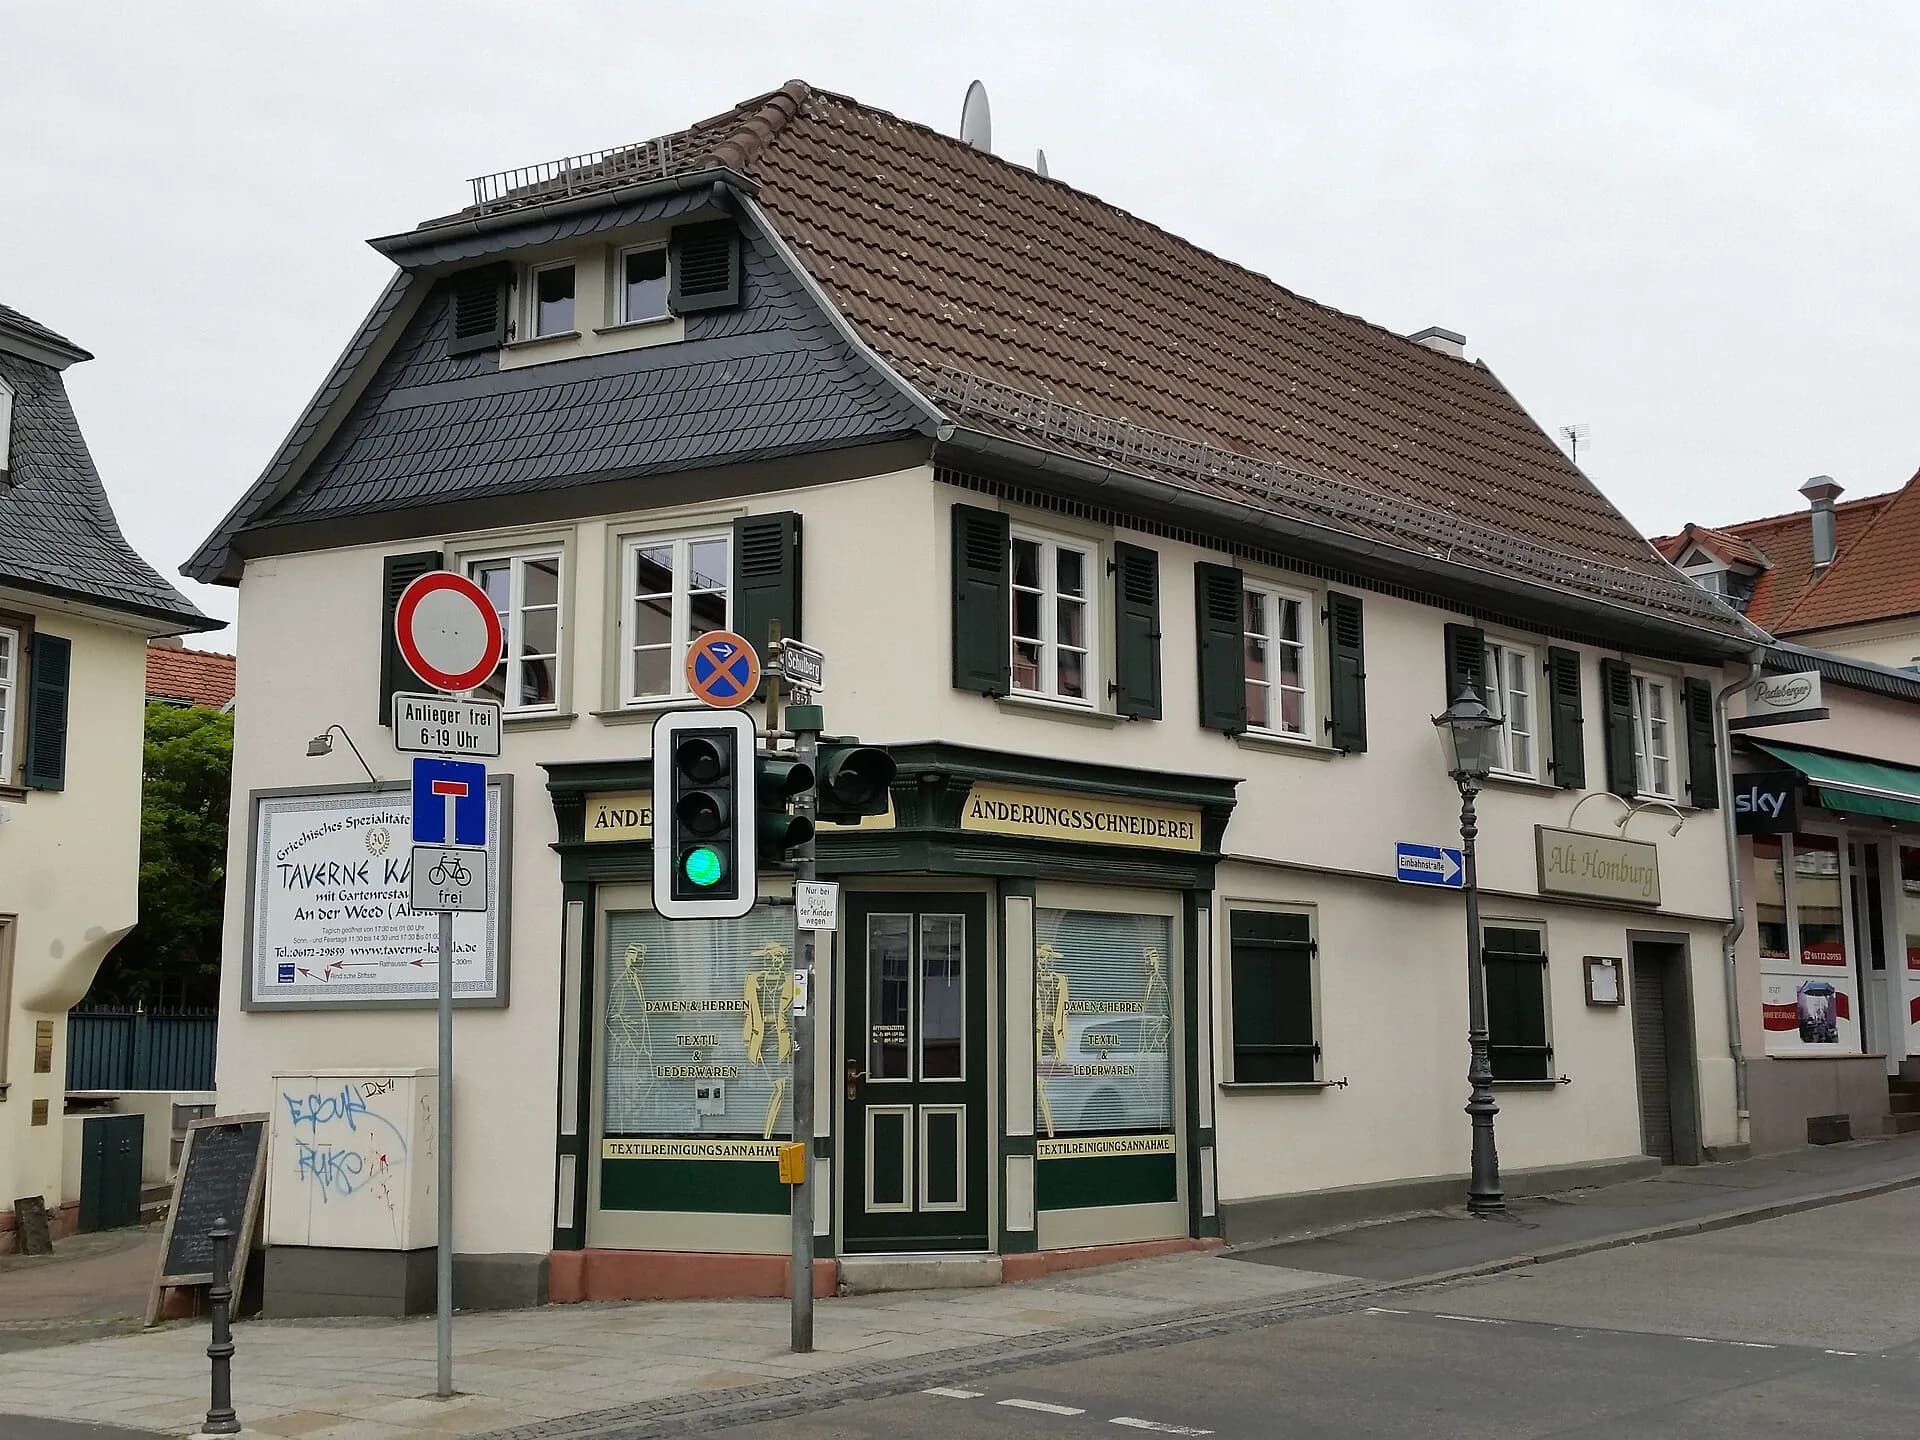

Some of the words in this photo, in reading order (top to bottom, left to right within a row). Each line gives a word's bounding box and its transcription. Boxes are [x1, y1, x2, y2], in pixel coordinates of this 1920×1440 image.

[788, 651, 820, 680] Schulberg
[1754, 681, 1808, 701] Radeberger
[405, 703, 460, 725] Anlieger
[469, 708, 491, 726] frei
[420, 728, 450, 747] 6-19
[457, 731, 478, 748] Uhr
[1736, 786, 1787, 818] sky
[594, 806, 652, 829] ÄNDE
[969, 794, 1194, 840] ÄNDERUNGSSCHNEIDEREI
[276, 822, 343, 861] Griechisches
[345, 811, 411, 830] Spezialitäte
[371, 832, 385, 846] 30
[1400, 857, 1445, 871] Einbahnstraße
[1548, 844, 1577, 875] Alt
[1581, 849, 1654, 897] Homburg
[276, 861, 369, 891] TAVERNE
[315, 891, 336, 902] mit
[338, 889, 409, 901] Gartenrestau
[438, 889, 463, 904] frei
[805, 886, 817, 895] Nur
[819, 887, 830, 895] bei
[294, 907, 315, 921] An
[318, 908, 341, 920] der
[344, 905, 384, 919] Weed
[800, 907, 811, 915] der
[812, 908, 833, 917] Kinder
[806, 918, 826, 926] wegen
[646, 1001, 692, 1012] DAMEN
[690, 1001, 699, 1011] &
[701, 1001, 750, 1011] HERREN
[1064, 1001, 1097, 1012] DAMEN
[1098, 1003, 1107, 1012] &
[1107, 1002, 1144, 1013] HERREN
[677, 1035, 719, 1046] TEXTIL
[1088, 1035, 1120, 1045] TEXTIL
[692, 1051, 702, 1062] &
[1101, 1050, 1108, 1060] &
[656, 1066, 738, 1078] LEDERWAREN
[1073, 1065, 1136, 1076] LEDERWAREN
[609, 1143, 781, 1157] TEXTILREINIGUNGSANNAHME
[1038, 1139, 1170, 1155] TEXTILREINIGUNGSANNAHME
